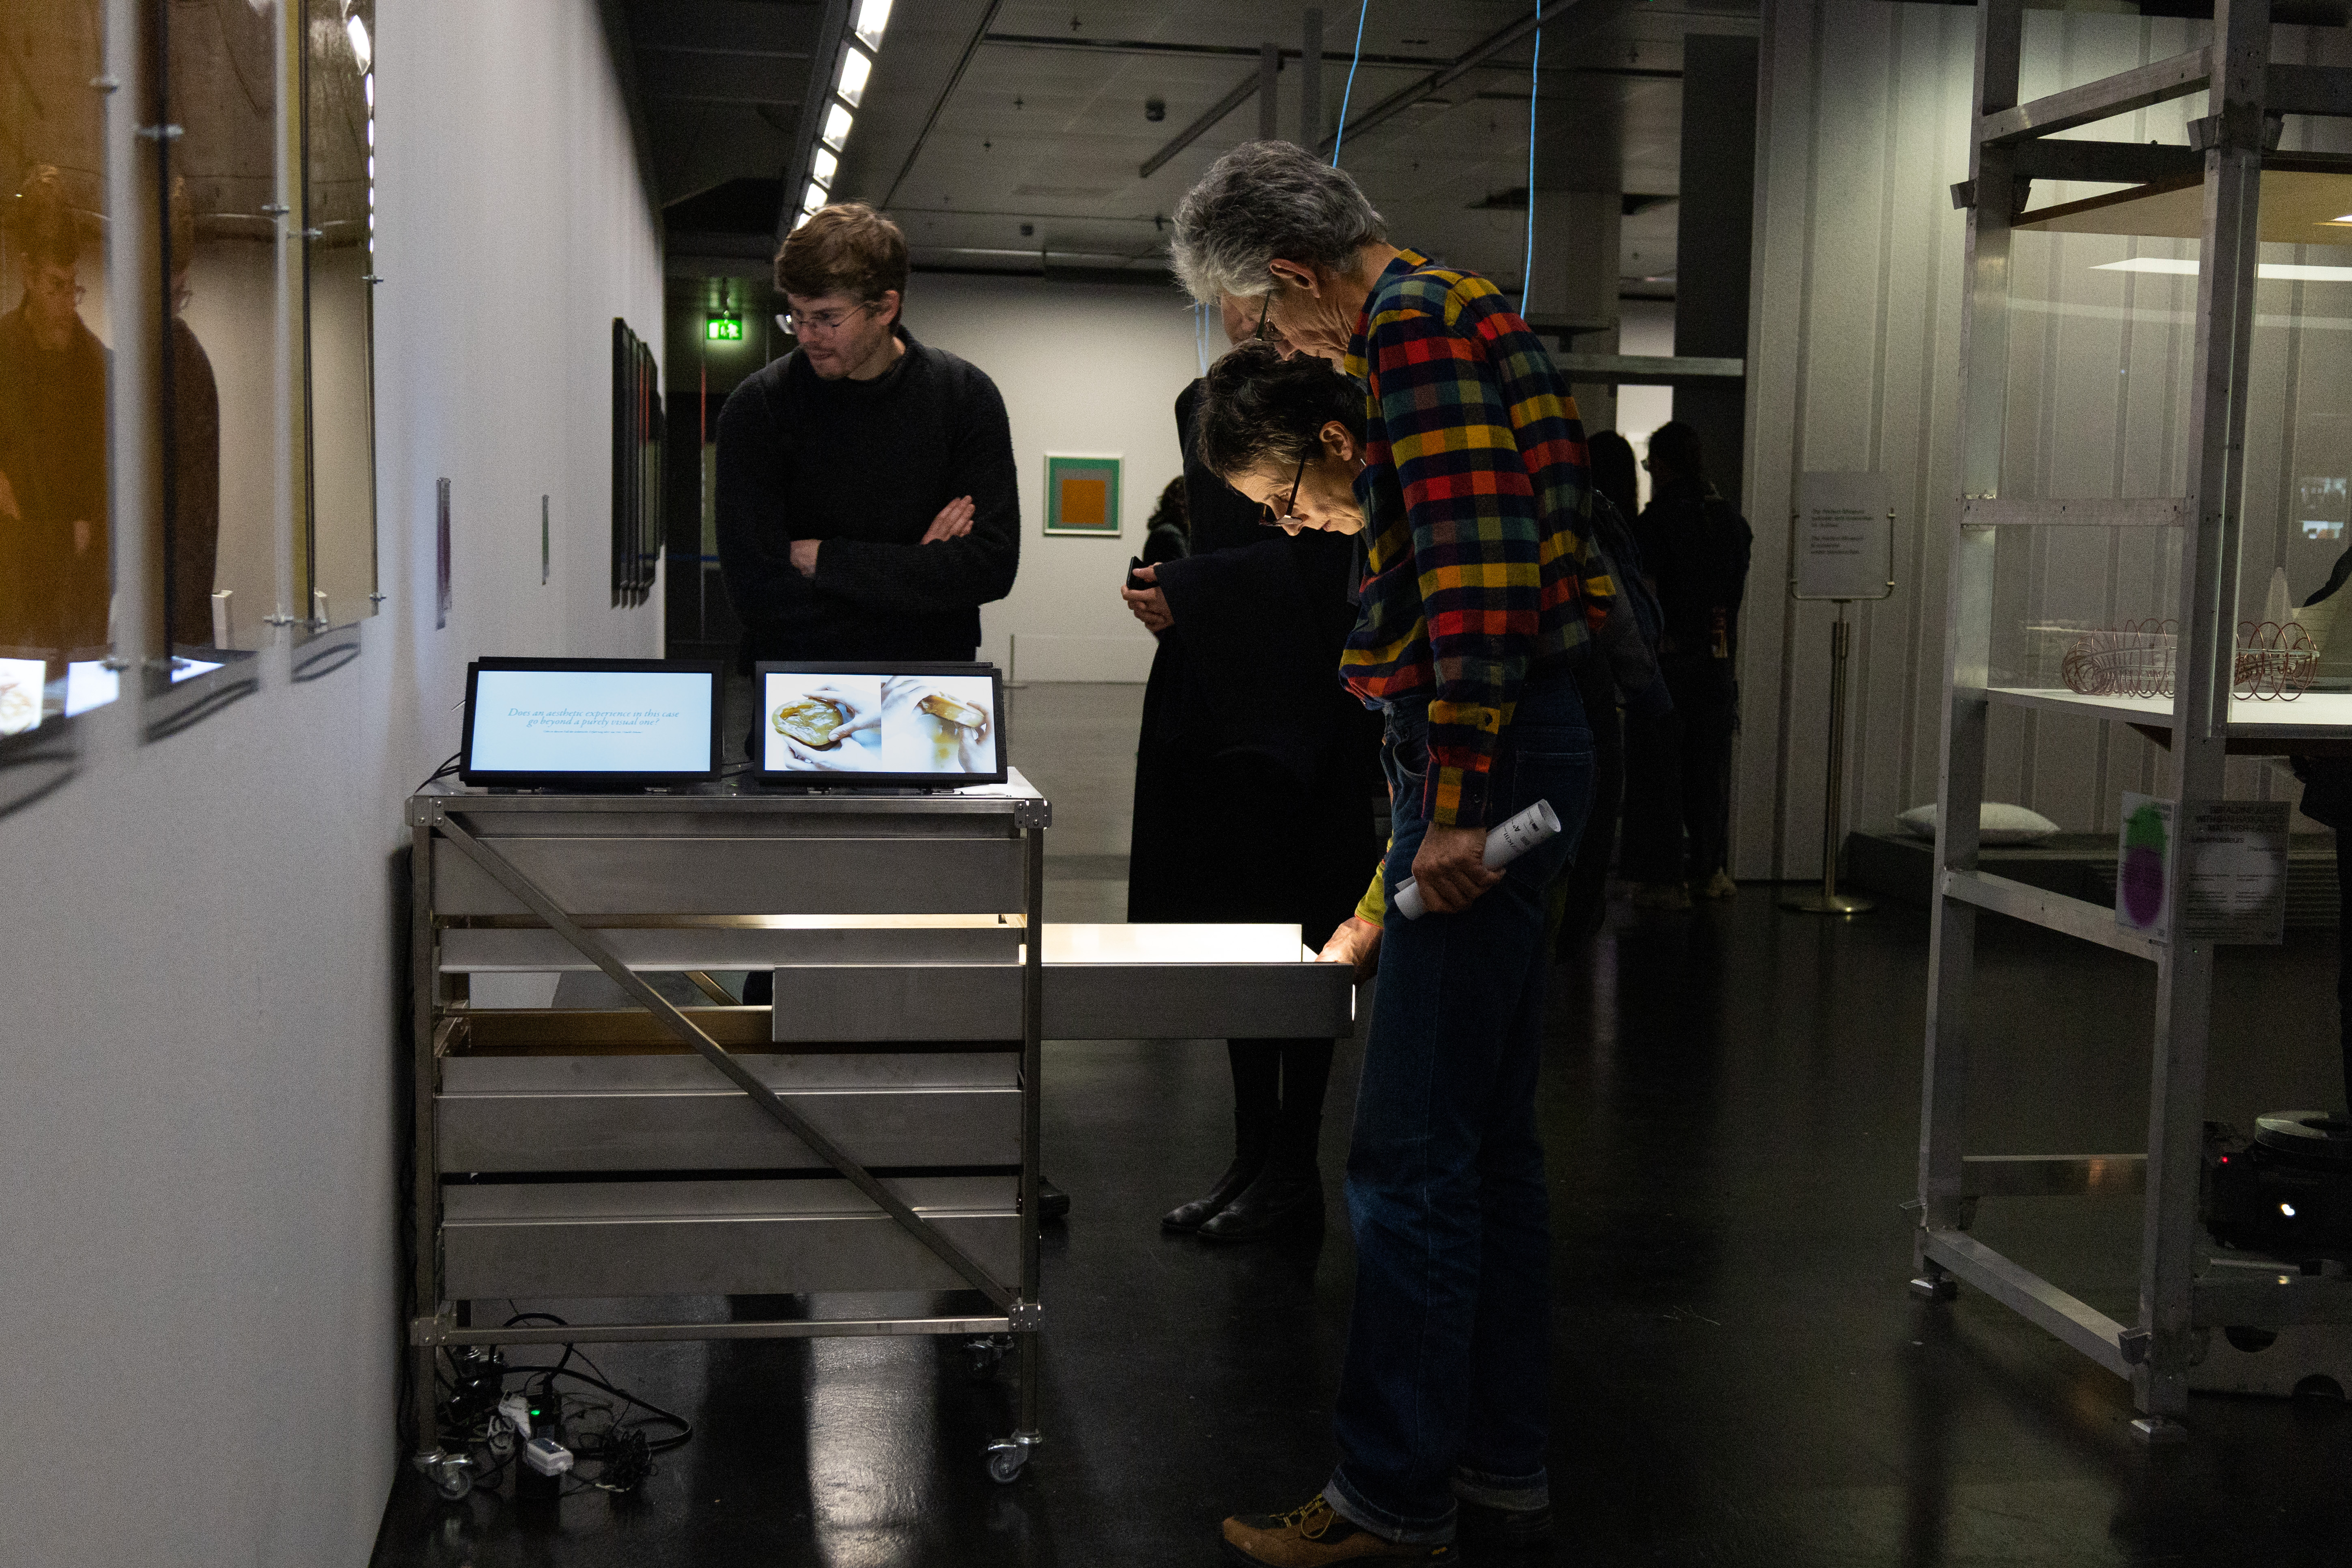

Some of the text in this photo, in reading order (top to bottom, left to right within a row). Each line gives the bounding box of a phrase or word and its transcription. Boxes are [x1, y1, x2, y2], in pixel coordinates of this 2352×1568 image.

[508, 708, 531, 716] Does
[546, 708, 584, 717] aesthetic
[585, 711, 631, 719] experience
[644, 709, 660, 717] this
[526, 719, 538, 728] go
[540, 716, 573, 727] beyond
[580, 717, 609, 728] purely
[611, 717, 639, 725] visual
